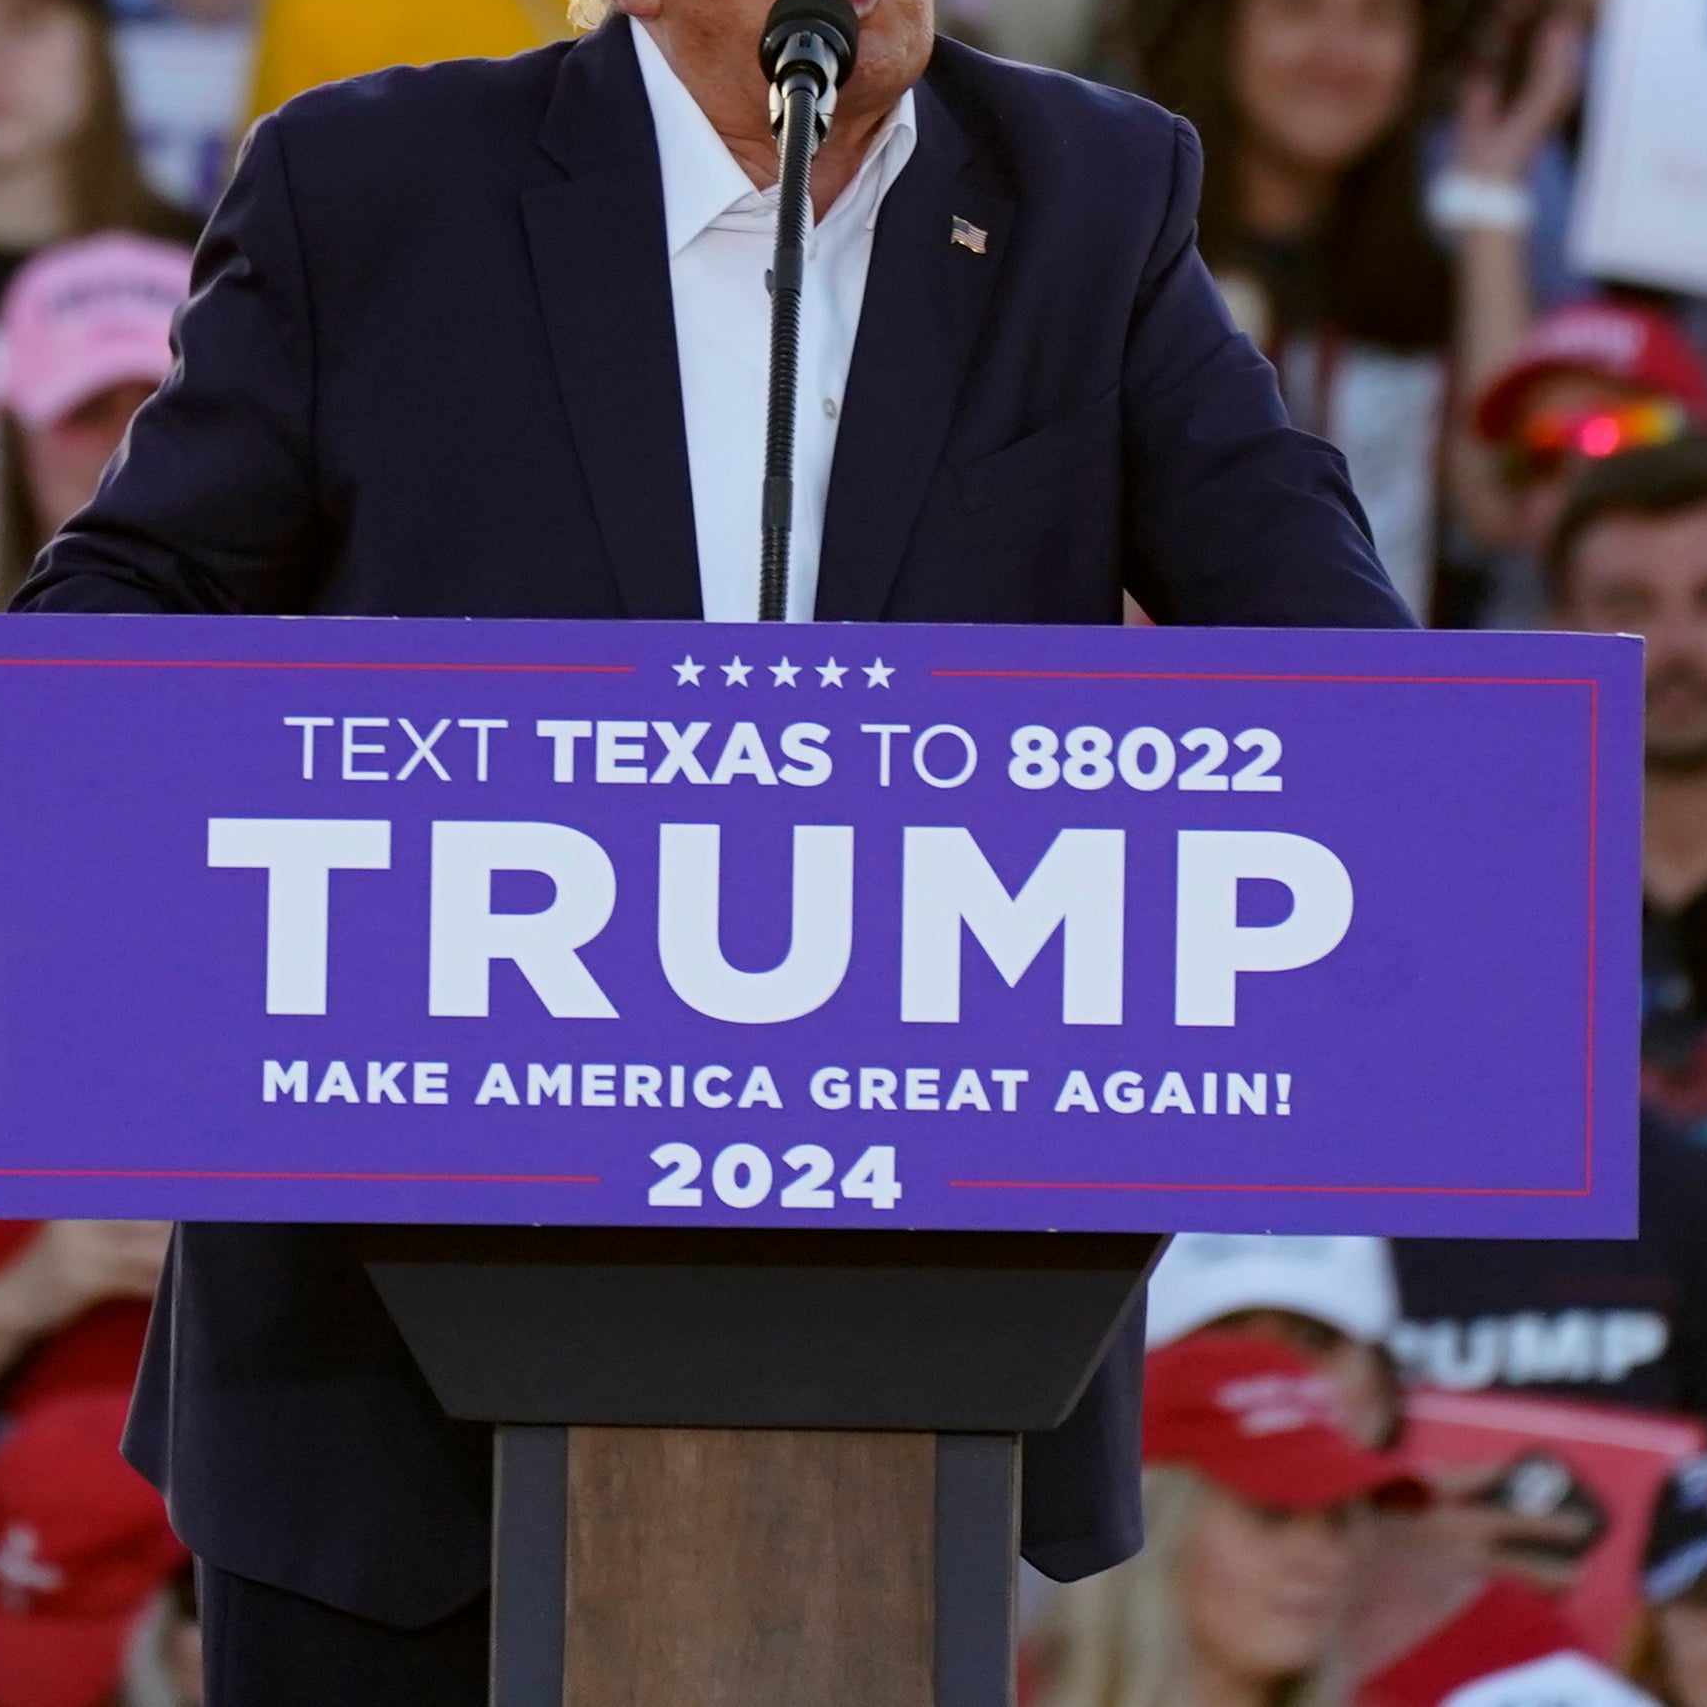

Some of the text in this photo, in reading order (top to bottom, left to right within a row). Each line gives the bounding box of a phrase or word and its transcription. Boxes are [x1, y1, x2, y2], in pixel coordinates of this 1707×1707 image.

[284, 717, 1282, 791] TEXT TEXAS TO 88022
[208, 818, 1353, 1026] TRUMP
[262, 1061, 1292, 1116] MAKE AMERICA GREAT AGAIN!
[649, 1142, 902, 1209] 2024
